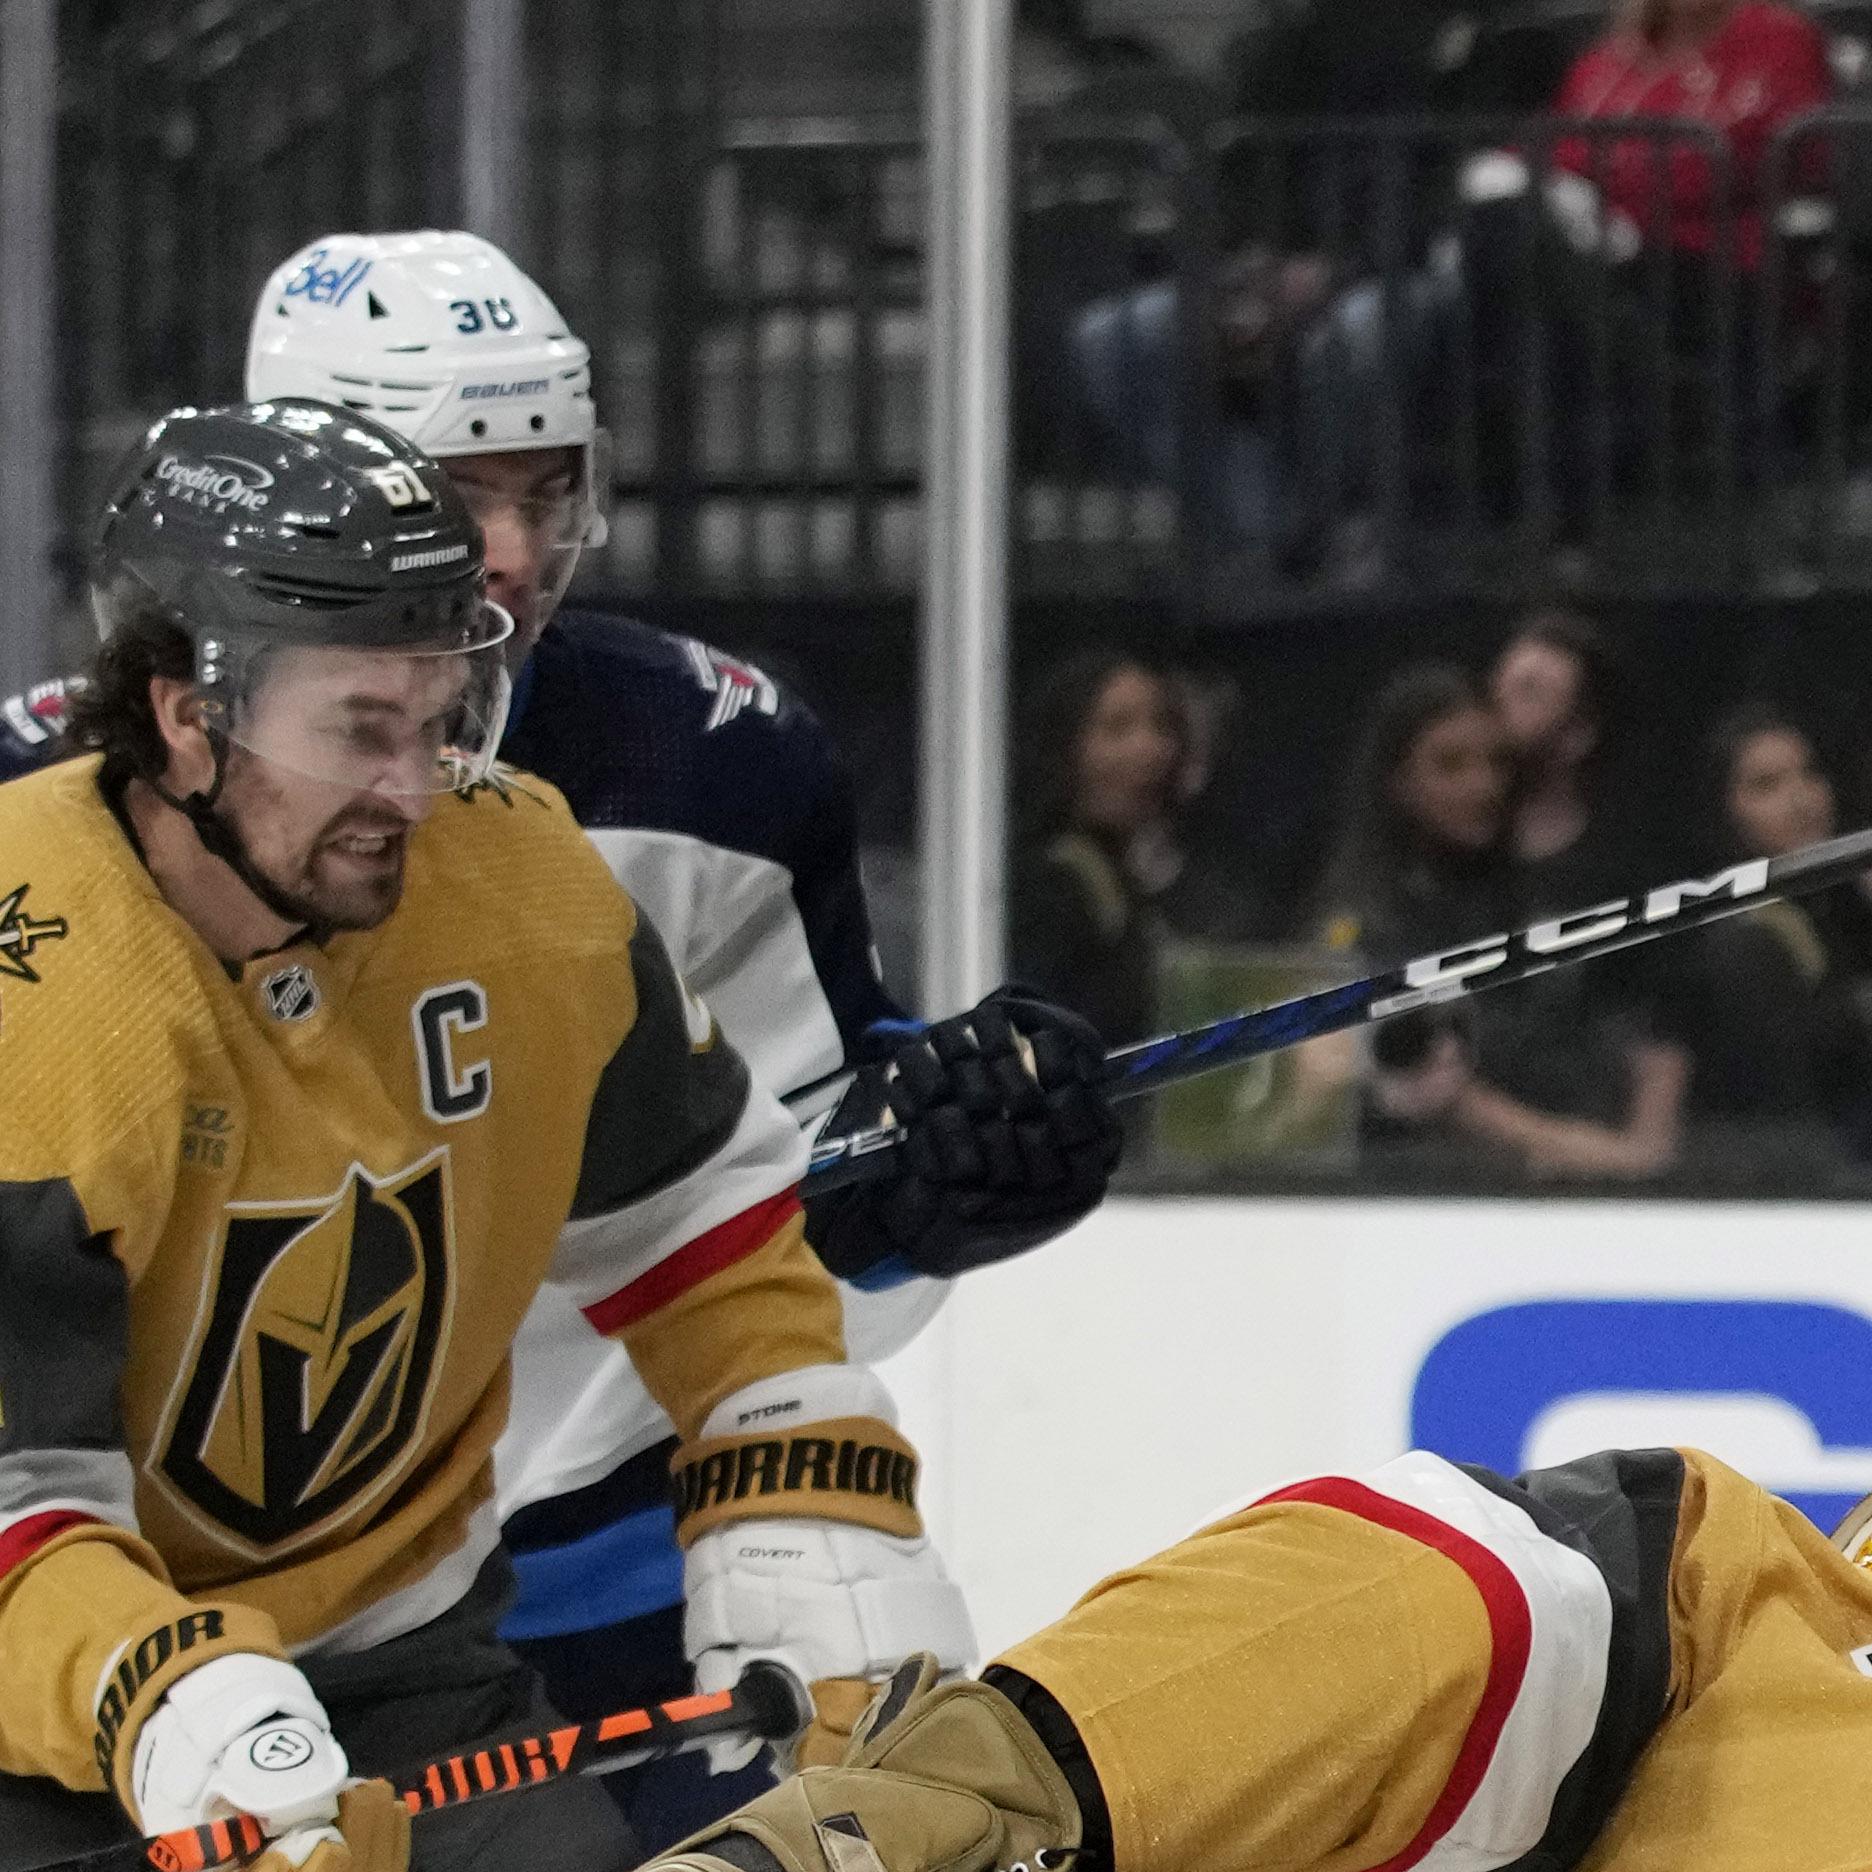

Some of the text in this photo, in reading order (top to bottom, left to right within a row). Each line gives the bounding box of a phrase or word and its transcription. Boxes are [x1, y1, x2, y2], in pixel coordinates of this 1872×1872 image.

[286, 249, 373, 307] Bell
[1405, 858, 1770, 987] CCM
[410, 979, 493, 1124] C
[737, 1399, 802, 1426] STONE
[736, 1545, 807, 1562] COVERT
